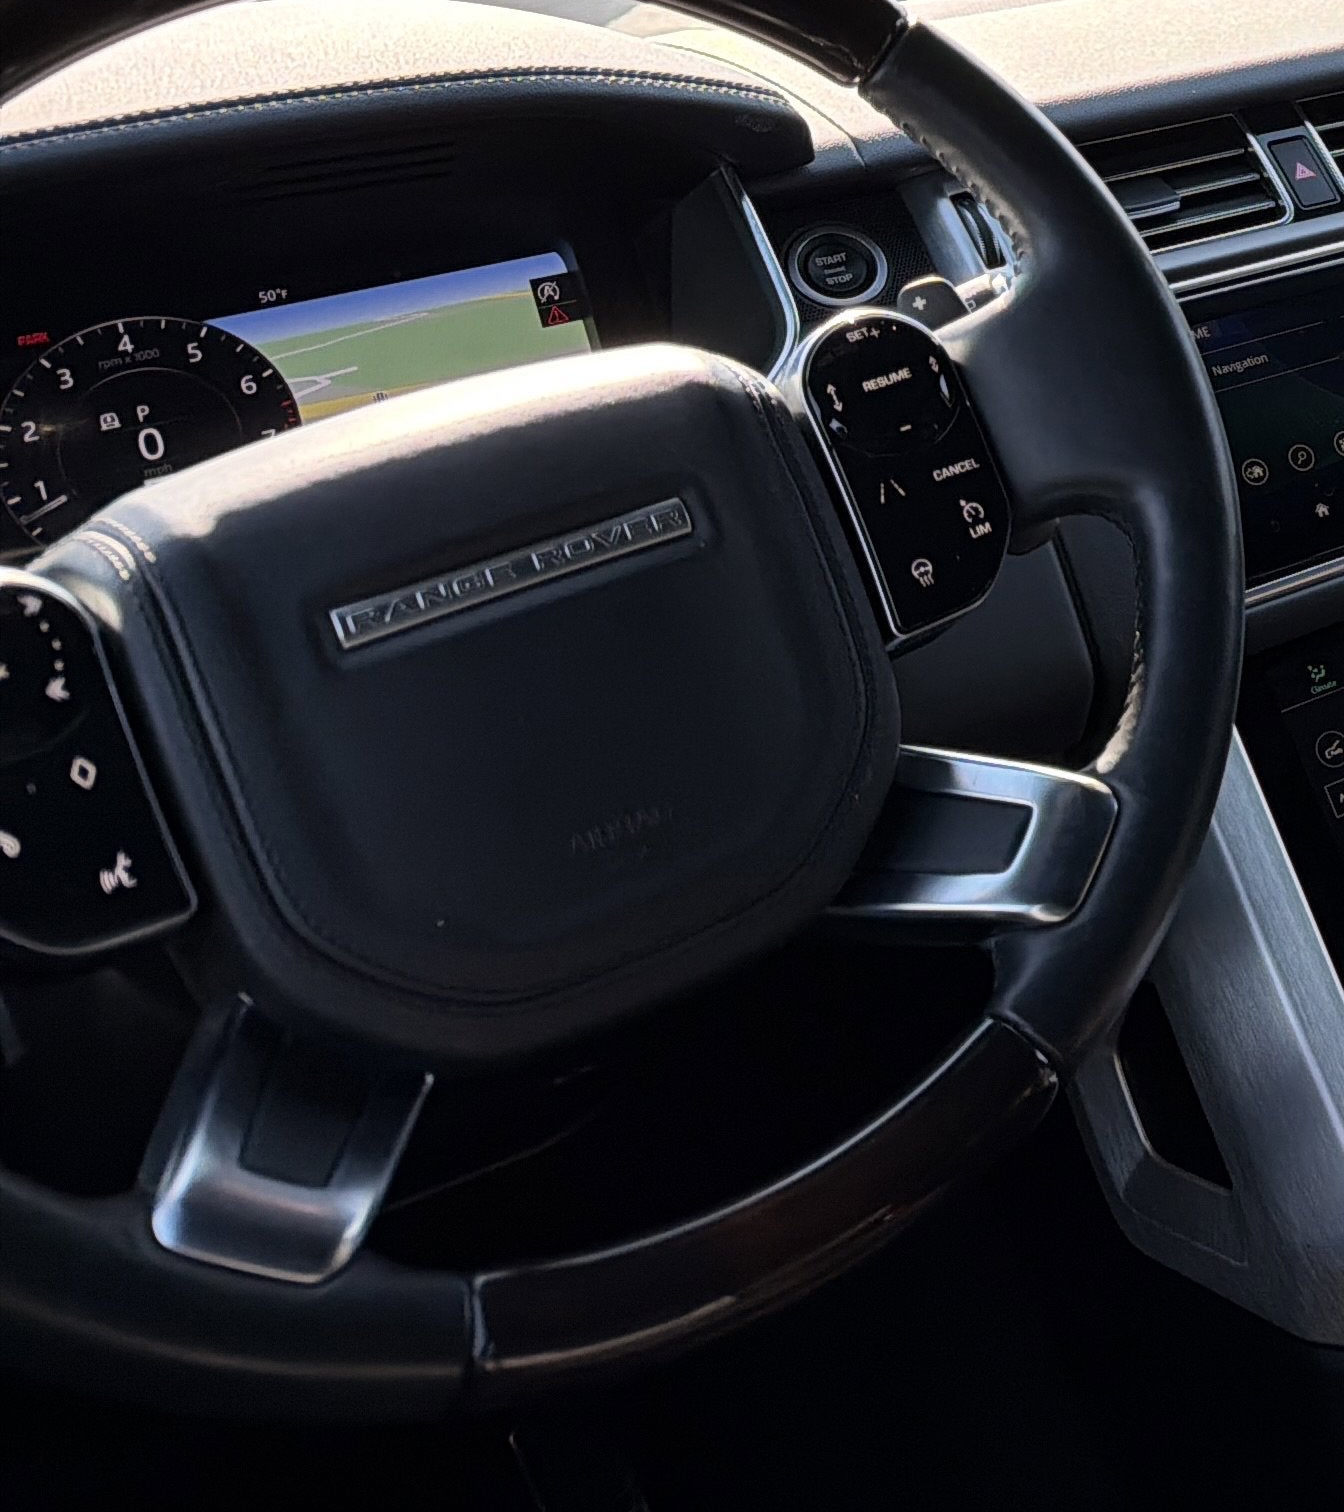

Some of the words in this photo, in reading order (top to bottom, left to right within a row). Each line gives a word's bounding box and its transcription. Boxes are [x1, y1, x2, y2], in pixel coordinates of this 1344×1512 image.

[815, 252, 847, 267] START
[825, 273, 853, 286] STOP
[17, 331, 49, 347] PARK
[117, 334, 134, 354] 4
[98, 356, 123, 370] rpm
[134, 348, 160, 364] 1000
[187, 342, 203, 364] 5
[1211, 352, 1269, 377] Navigation
[56, 368, 74, 389] 3
[240, 374, 258, 395] 6
[862, 367, 912, 392] RESUME
[136, 405, 150, 423] P
[21, 421, 40, 442] 2
[138, 427, 165, 461] 0
[144, 462, 173, 477] mph
[932, 458, 980, 482] CANCEL
[34, 480, 48, 501] 1
[969, 522, 992, 539] LIM
[344, 560, 518, 635] RANGE
[531, 507, 683, 572] ROVER
